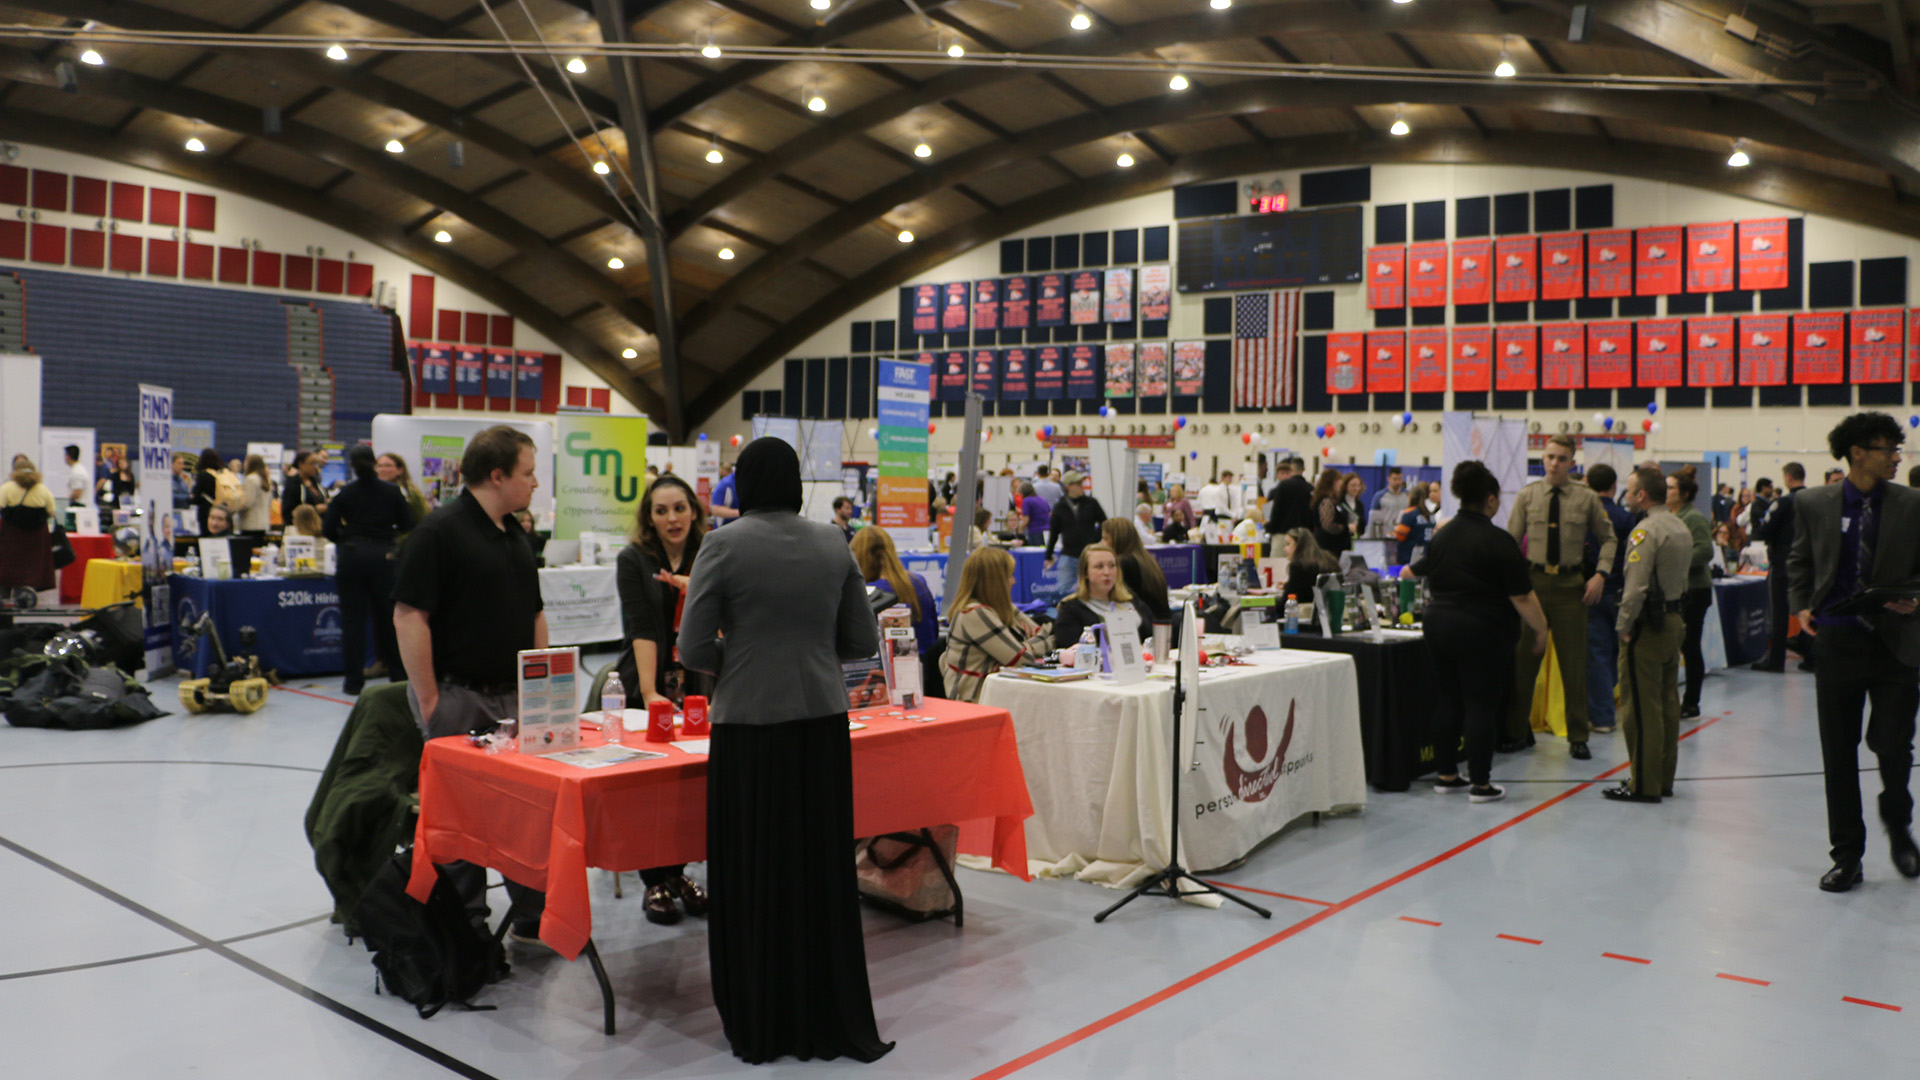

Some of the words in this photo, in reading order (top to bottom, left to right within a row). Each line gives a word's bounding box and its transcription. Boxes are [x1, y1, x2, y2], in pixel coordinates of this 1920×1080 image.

[142, 393, 170, 420] FIND
[142, 420, 170, 443] YOUR
[142, 445, 170, 470] WHY
[278, 591, 313, 608] $20k
[315, 593, 341, 605] Hirin
